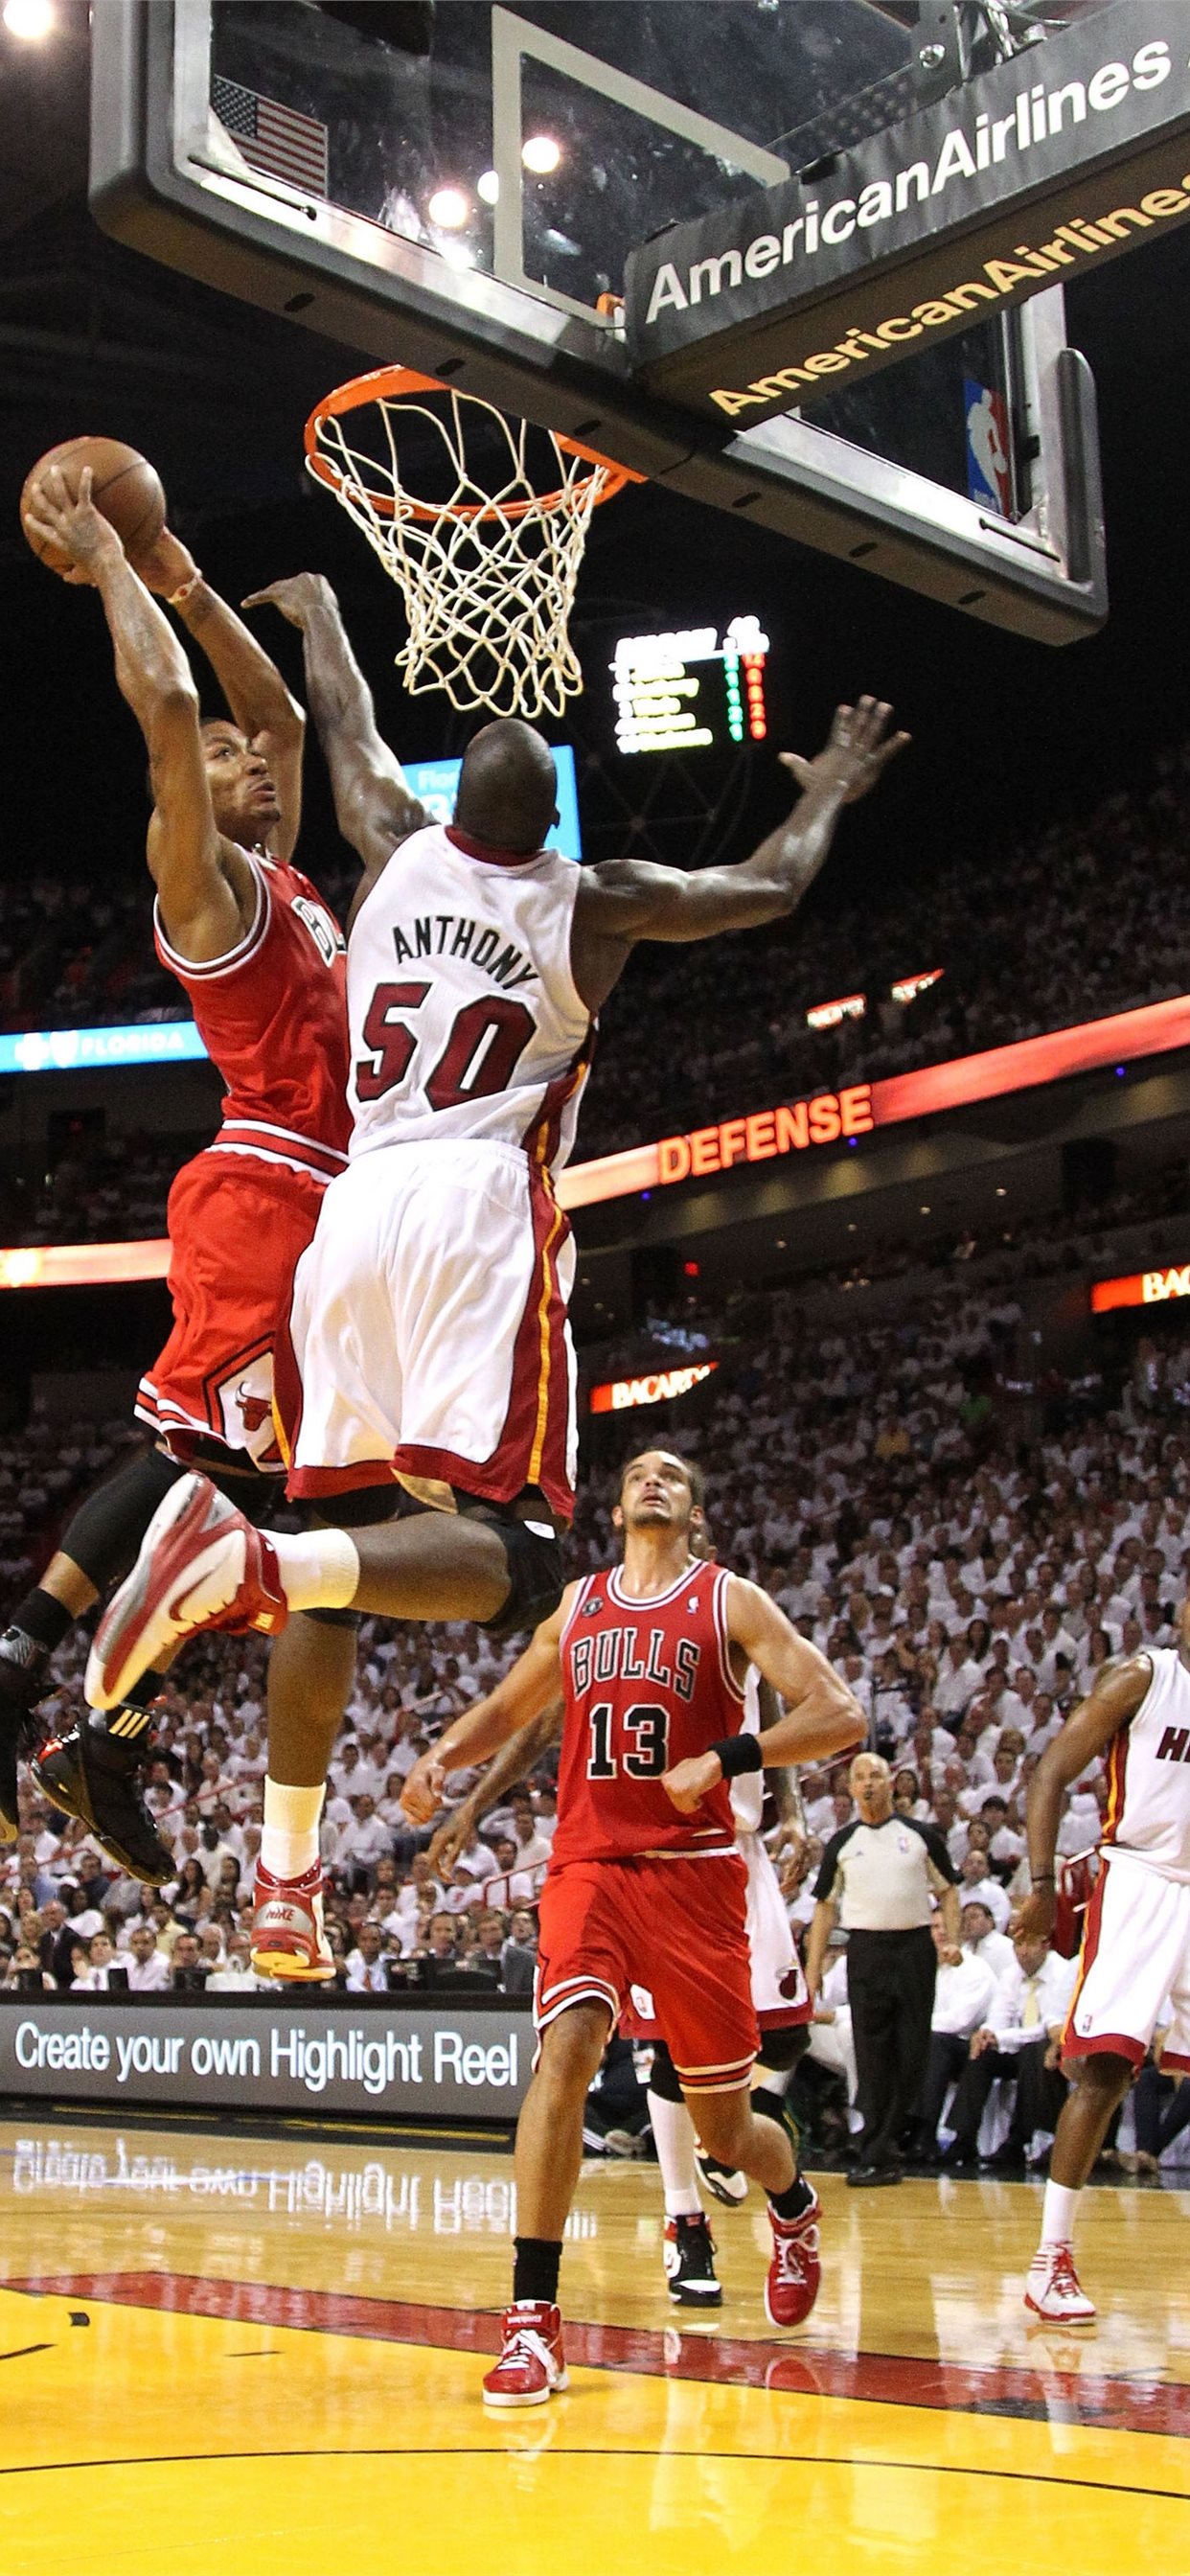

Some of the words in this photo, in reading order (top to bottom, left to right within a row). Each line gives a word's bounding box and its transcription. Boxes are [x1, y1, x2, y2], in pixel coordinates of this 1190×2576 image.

[646, 41, 1172, 324] AmericanAirlines
[708, 173, 1190, 416] AmericanAirline
[392, 915, 538, 990] ANTHONY
[80, 1031, 185, 1057] FLORIDA
[355, 981, 538, 1112] 50
[657, 1084, 874, 1184] DEFENSE
[571, 1627, 700, 1703] BULLS
[586, 1703, 670, 1781] 13
[1156, 1726, 1190, 1763] H
[15, 2021, 110, 2071] Create
[115, 2036, 185, 2082] your
[191, 2037, 261, 2077] own
[271, 2028, 423, 2094] Highlight
[434, 2031, 517, 2086] Reel
